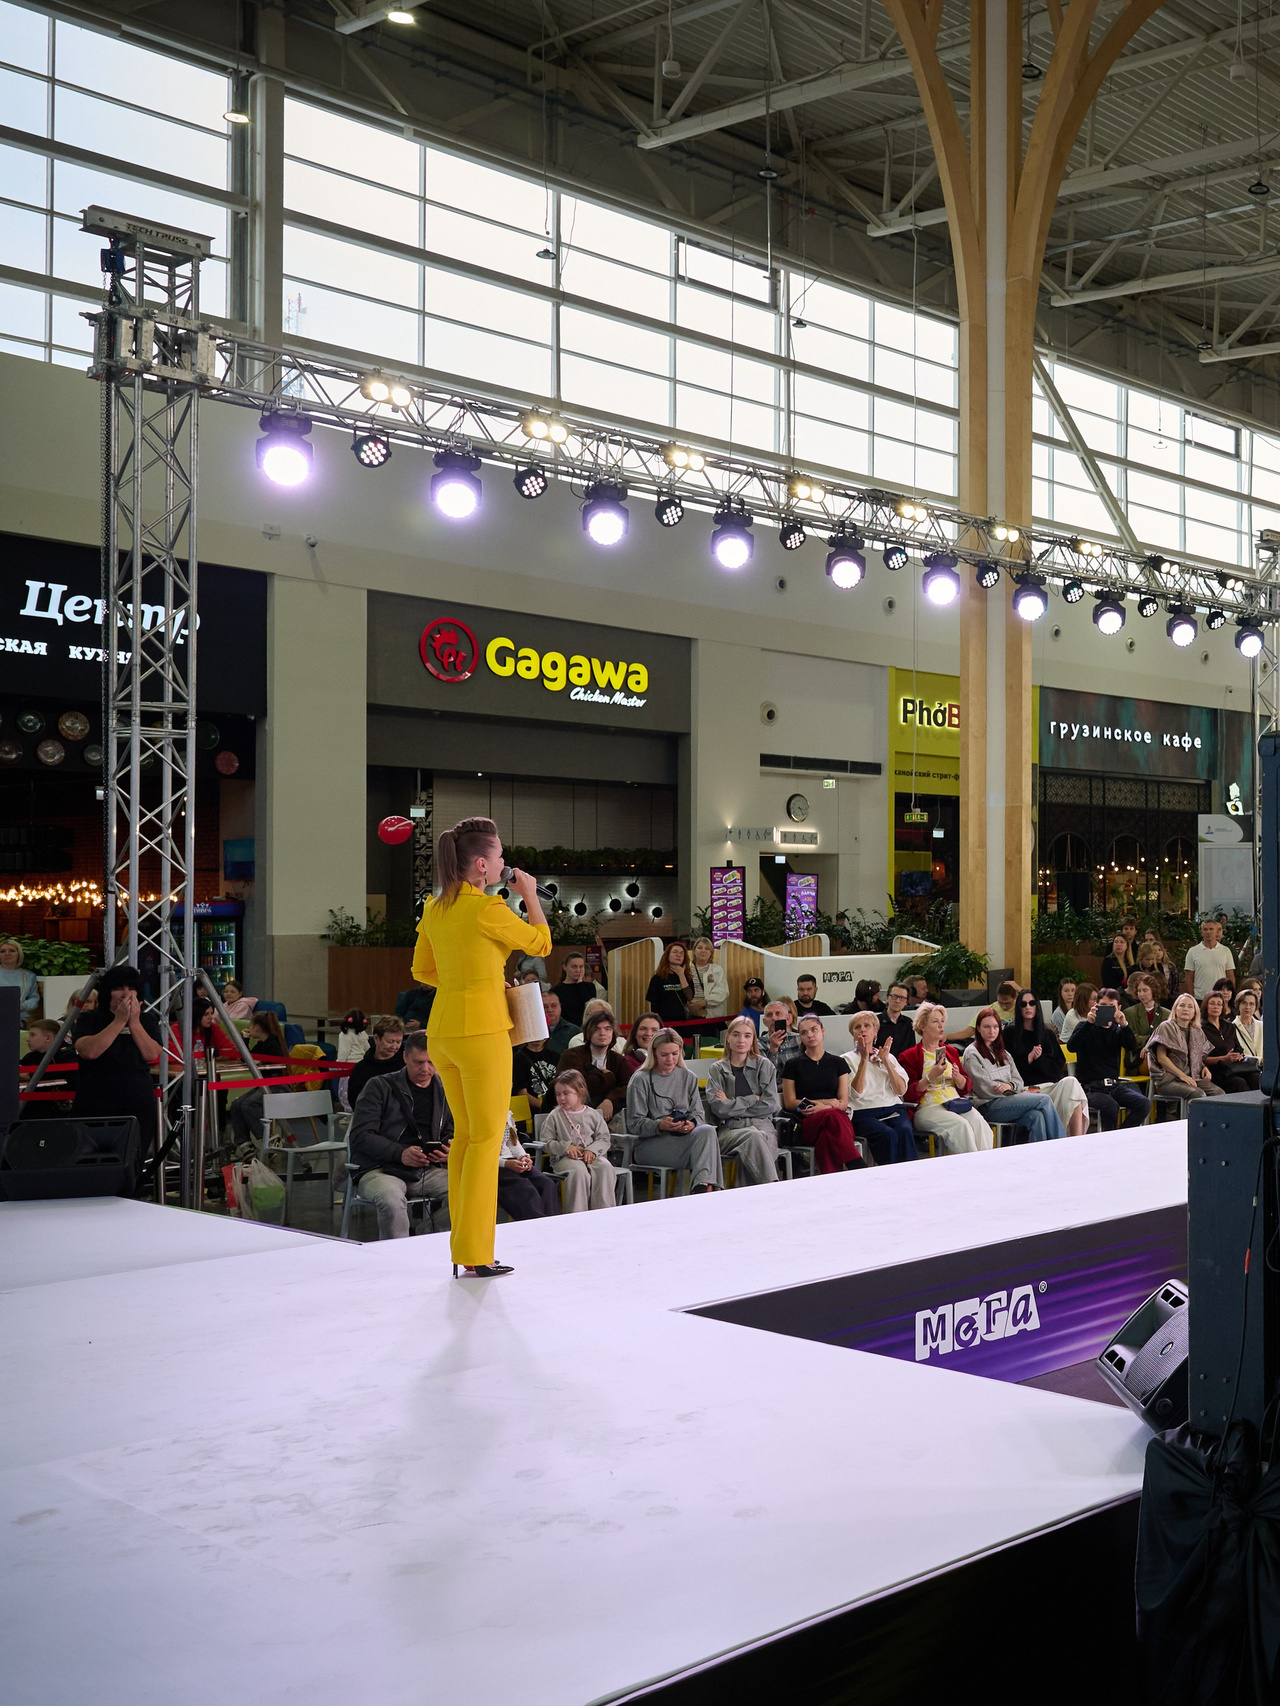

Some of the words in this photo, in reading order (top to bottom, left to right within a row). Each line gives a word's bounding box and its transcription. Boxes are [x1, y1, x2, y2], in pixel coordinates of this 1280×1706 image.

[485, 636, 649, 693] Gagawa
[570, 686, 611, 705] Chicken
[610, 691, 647, 708] Master
[1050, 720, 1152, 744] грузинское
[1163, 731, 1202, 752] кафе
[932, 770, 960, 782] стрит-ф
